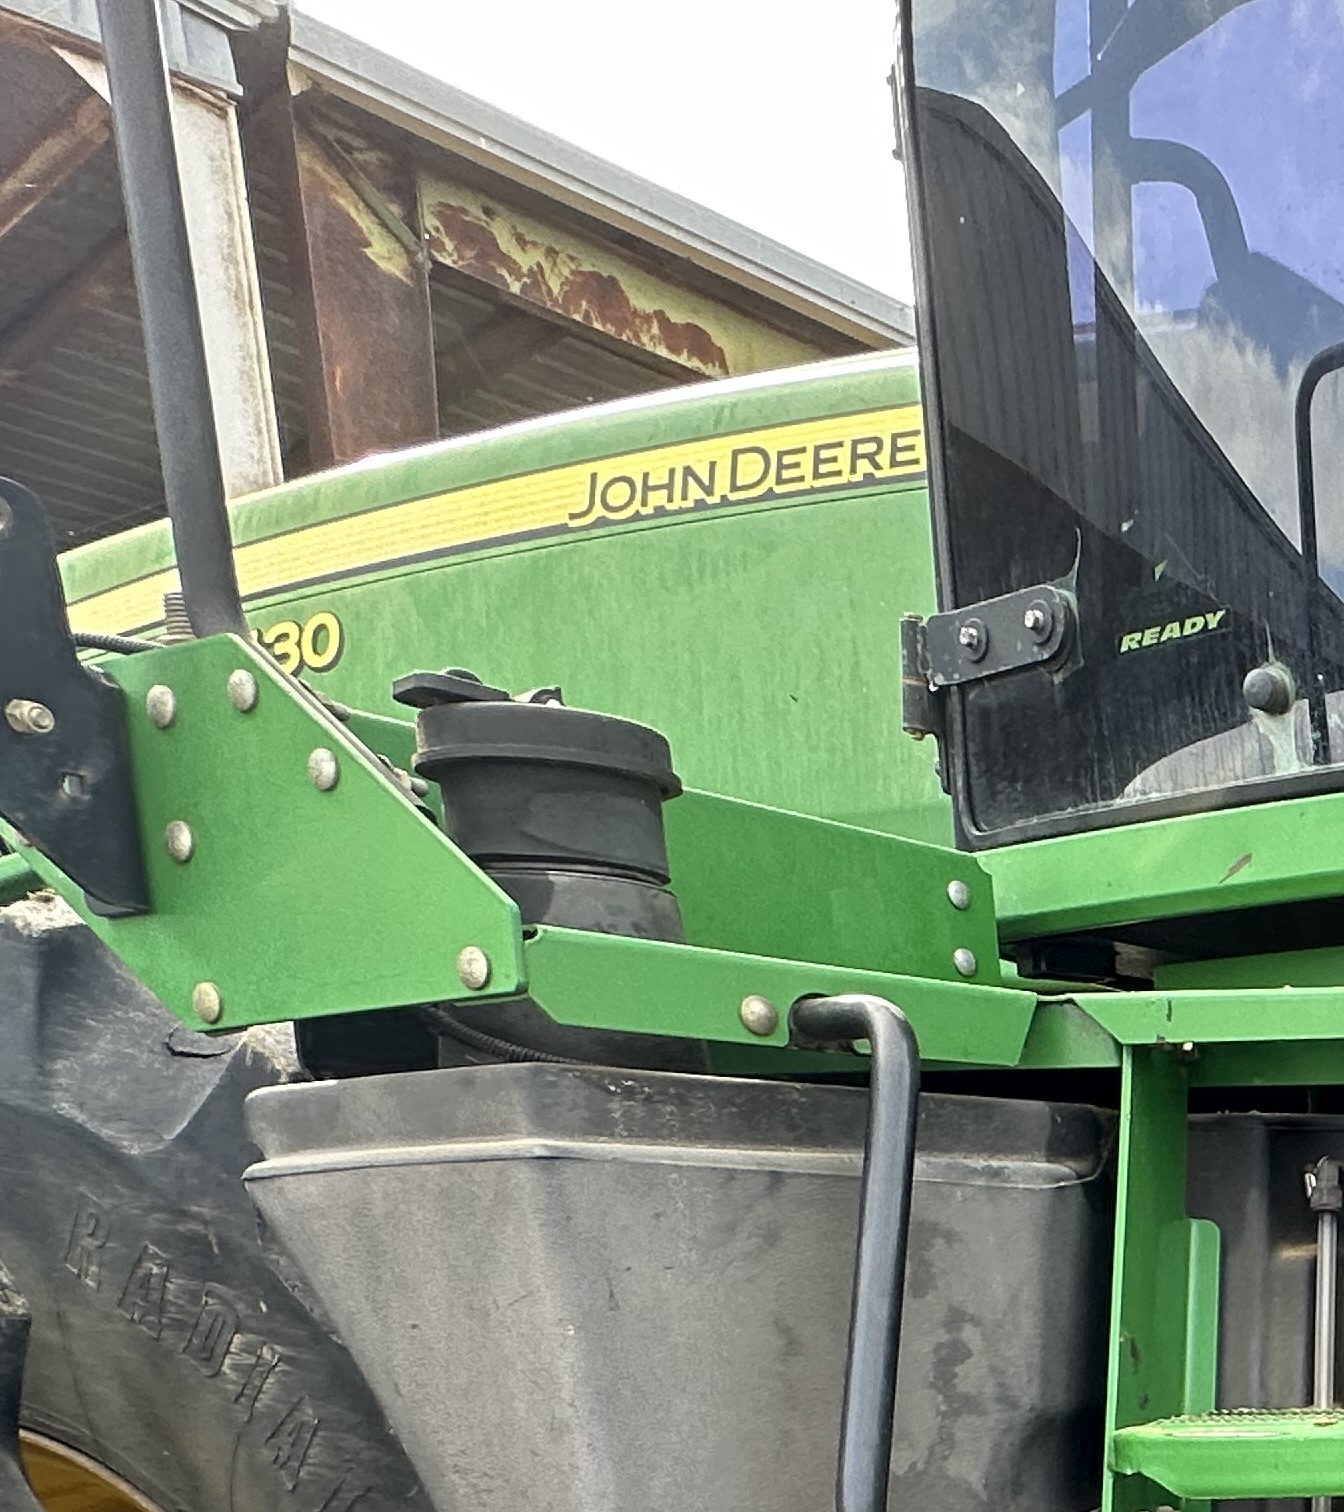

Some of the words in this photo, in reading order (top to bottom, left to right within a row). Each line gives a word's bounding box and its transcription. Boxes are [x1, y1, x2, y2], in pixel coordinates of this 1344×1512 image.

[567, 460, 717, 521] JOHN
[728, 429, 922, 494] DEERE
[250, 610, 346, 677] 30
[1120, 609, 1226, 653] READY
